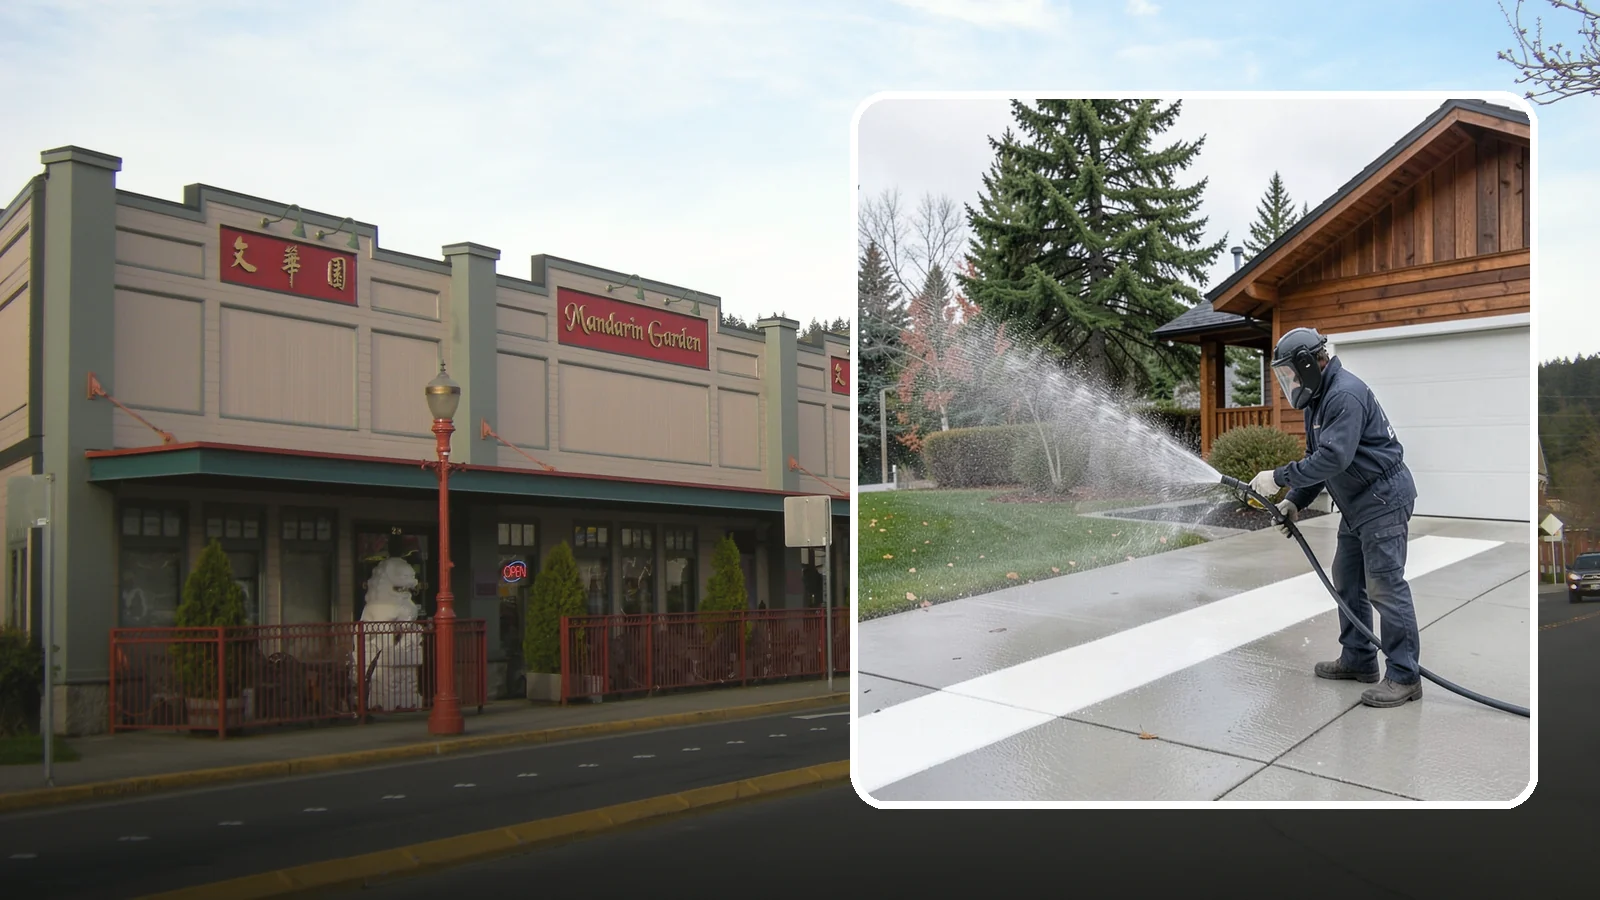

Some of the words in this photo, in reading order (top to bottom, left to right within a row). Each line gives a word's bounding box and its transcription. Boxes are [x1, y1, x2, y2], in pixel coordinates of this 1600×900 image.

[231, 236, 346, 290] 文華園
[564, 302, 644, 340] Mandarin
[648, 320, 702, 352] Garden
[503, 565, 527, 578] OPEN
